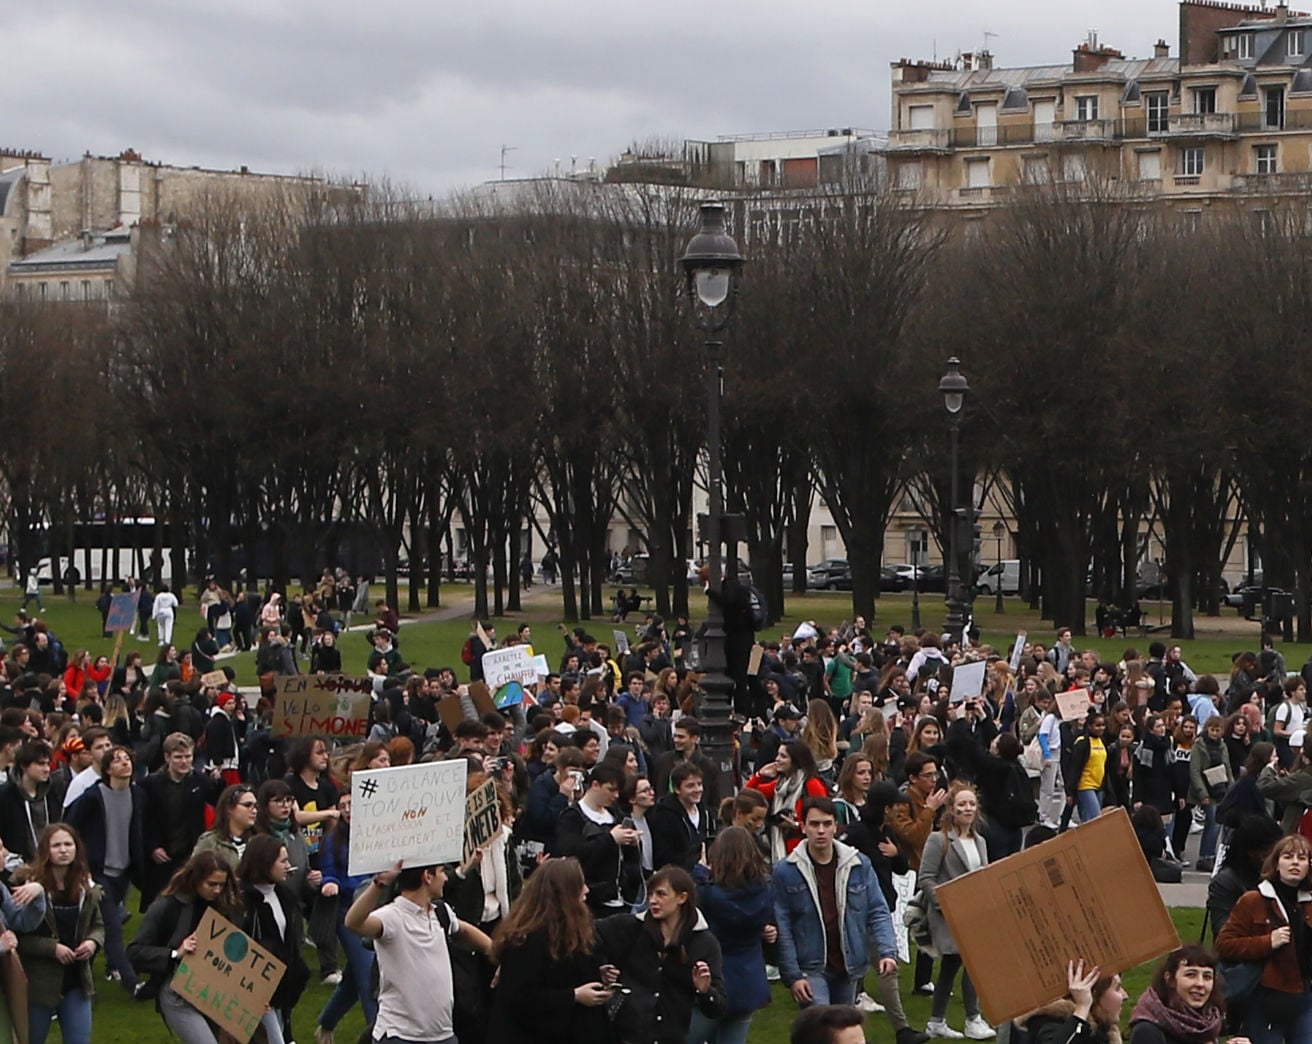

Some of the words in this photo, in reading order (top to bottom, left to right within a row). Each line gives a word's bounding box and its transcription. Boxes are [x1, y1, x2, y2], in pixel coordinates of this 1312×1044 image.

[284, 679, 306, 693] EN
[281, 716, 367, 737] SIMONE
[387, 766, 462, 793] BALANCE
[362, 799, 399, 818] TON
[402, 807, 427, 821] NON
[211, 919, 277, 981] VOTE
[204, 950, 233, 977] POUR
[239, 976, 254, 992] LA
